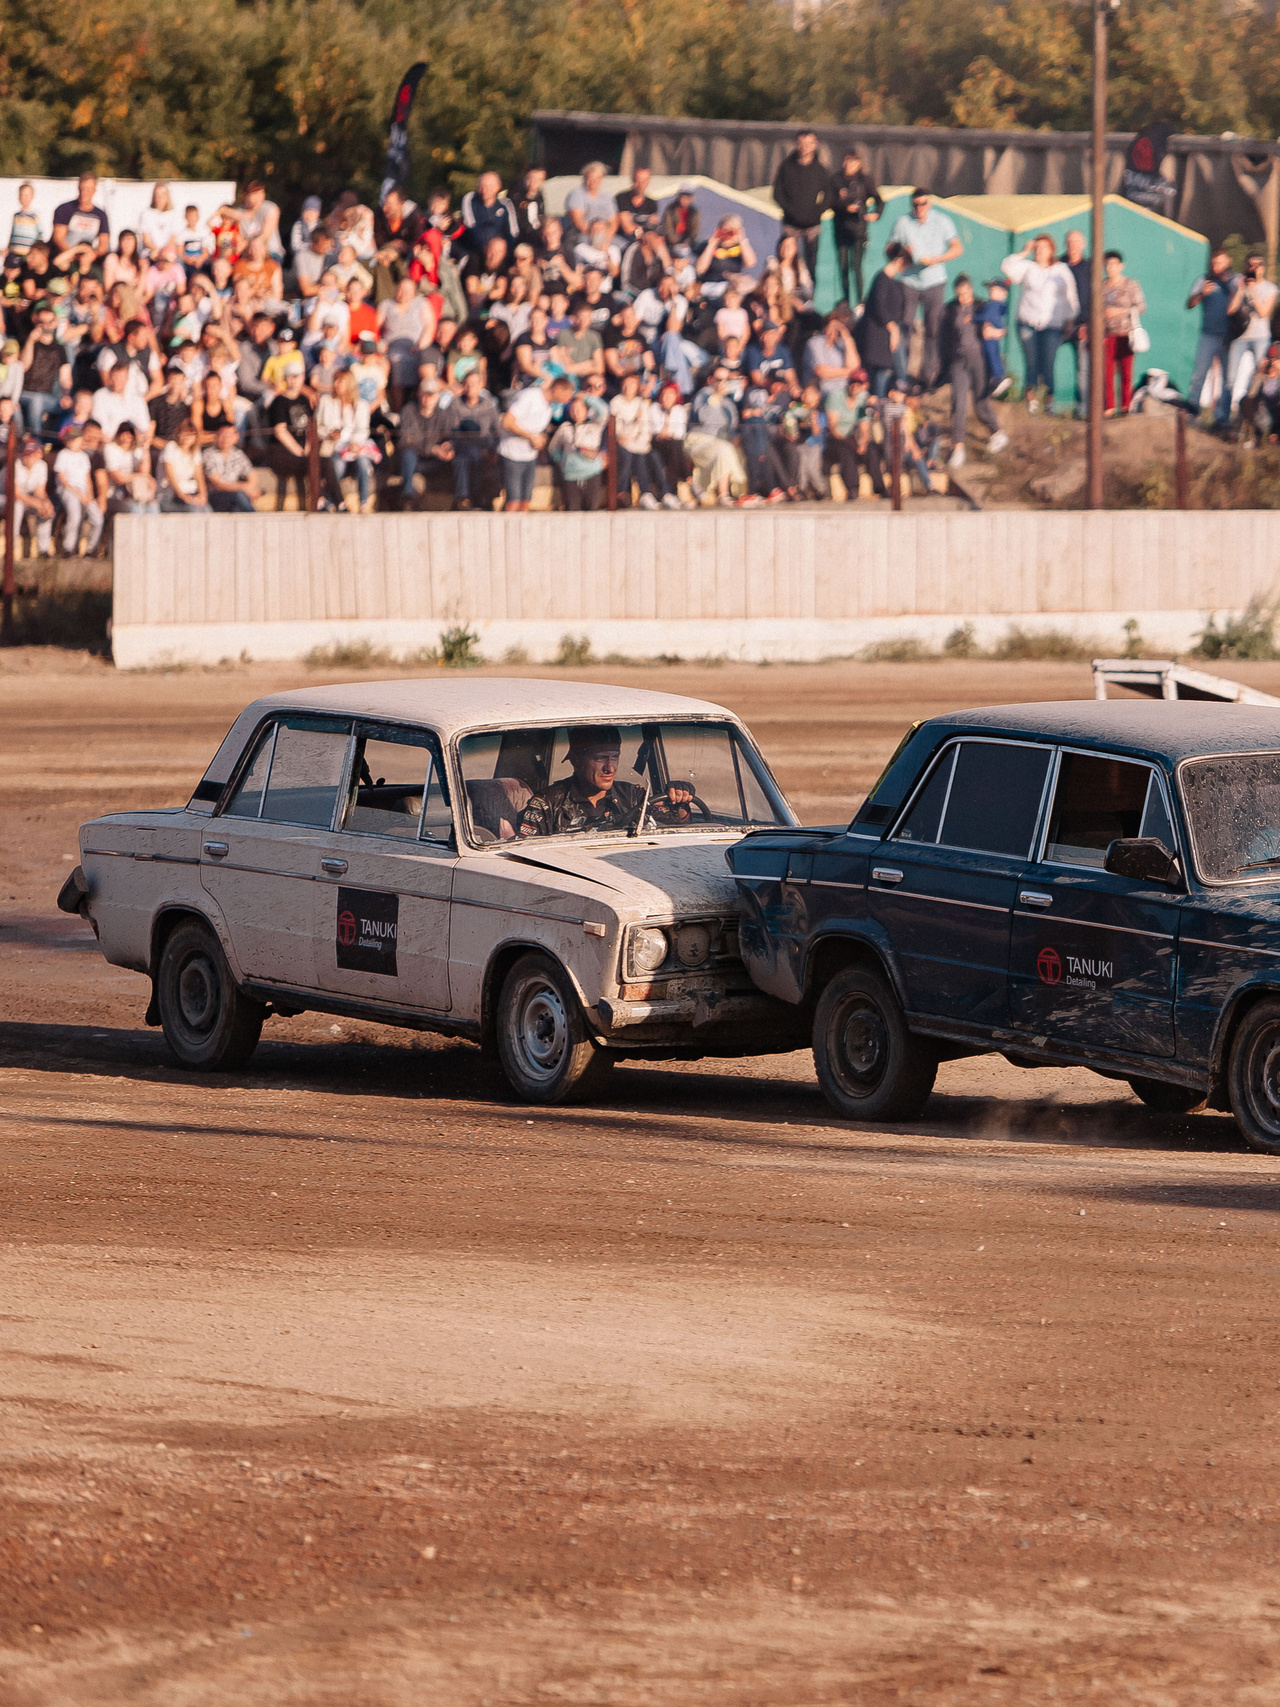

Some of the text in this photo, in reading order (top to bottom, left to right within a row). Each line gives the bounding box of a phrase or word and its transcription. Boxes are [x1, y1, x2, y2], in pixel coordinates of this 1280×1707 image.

[360, 918, 397, 939] TANUKI
[1066, 956, 1113, 978] TANUKI
[1066, 975, 1096, 991] Detailing
